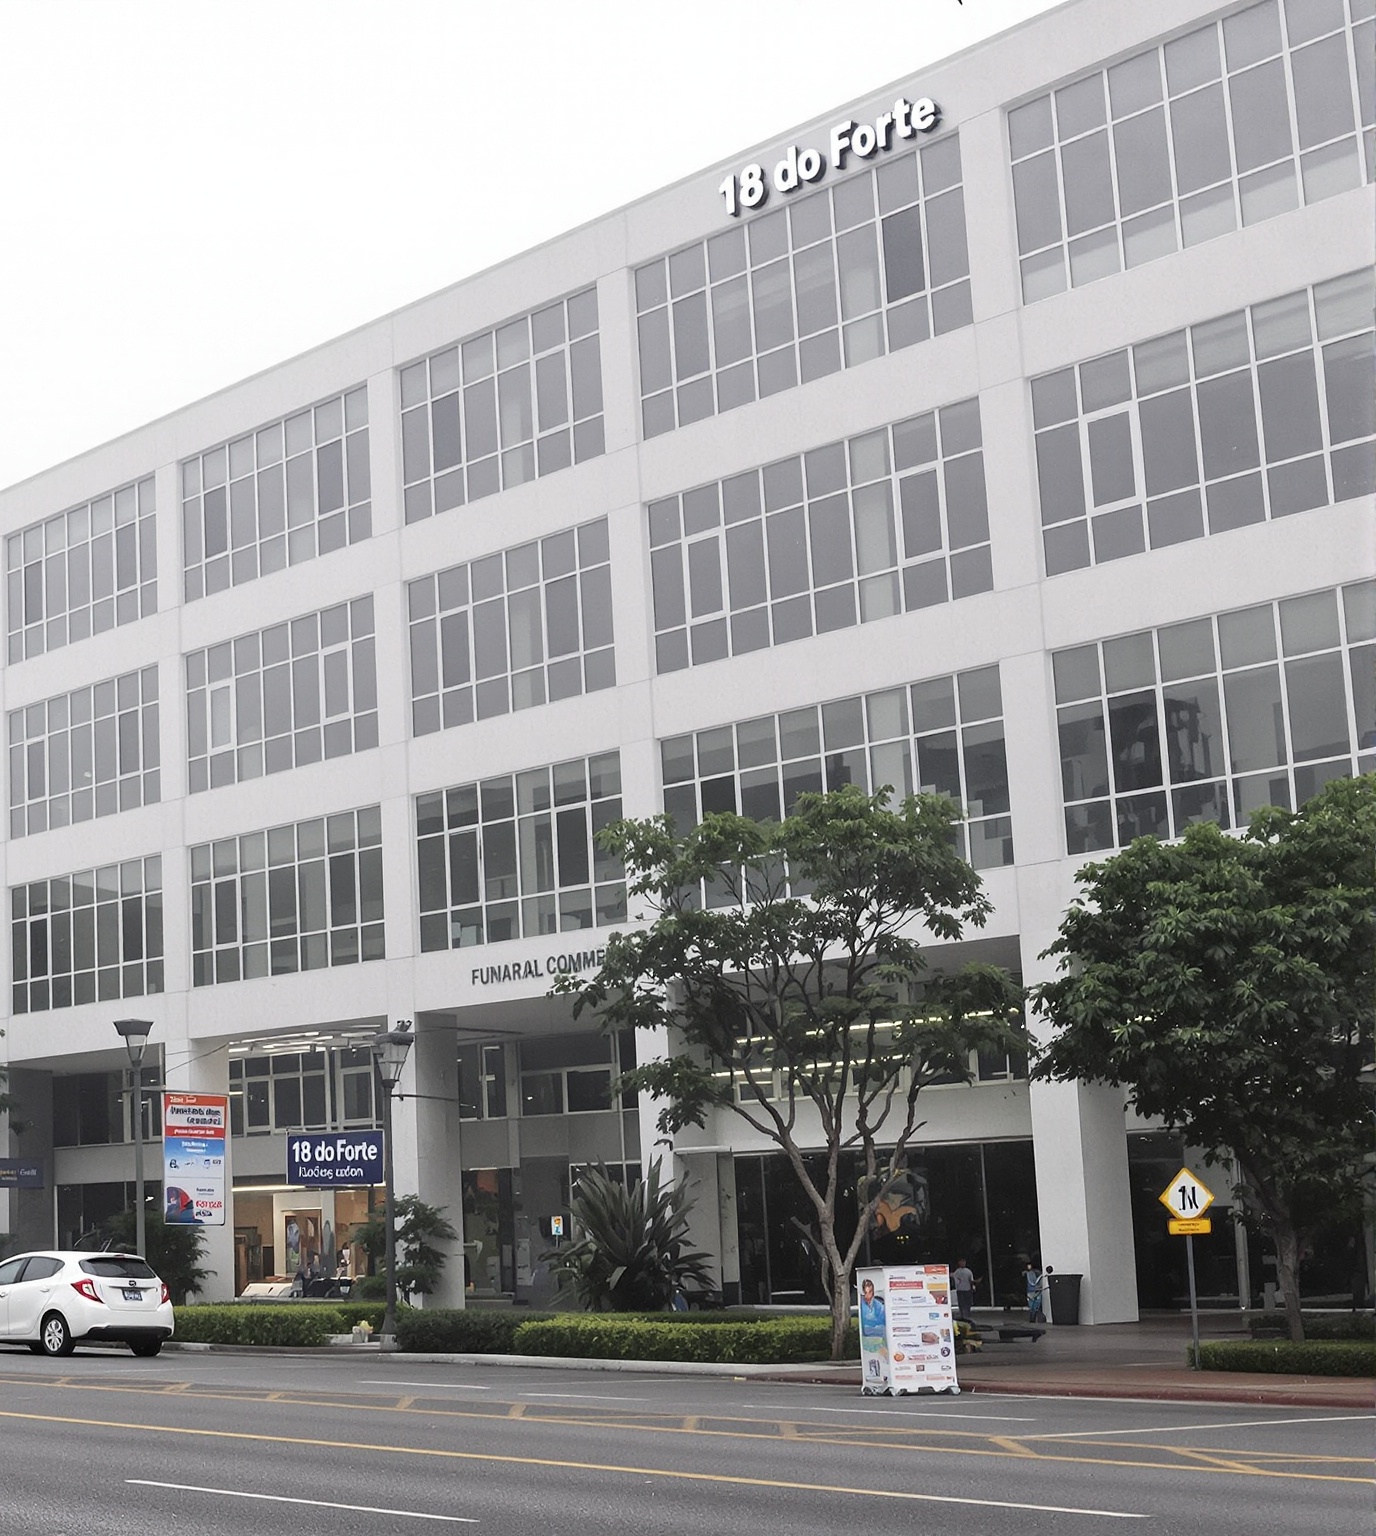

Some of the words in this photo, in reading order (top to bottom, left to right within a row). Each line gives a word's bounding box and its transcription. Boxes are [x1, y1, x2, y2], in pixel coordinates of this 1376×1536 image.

[719, 163, 766, 216] 18
[774, 145, 824, 192] do
[830, 97, 939, 168] Forte
[471, 959, 544, 985] FUNARAL
[292, 1140, 312, 1163] 18
[314, 1140, 335, 1162] do
[336, 1139, 378, 1162] Forte
